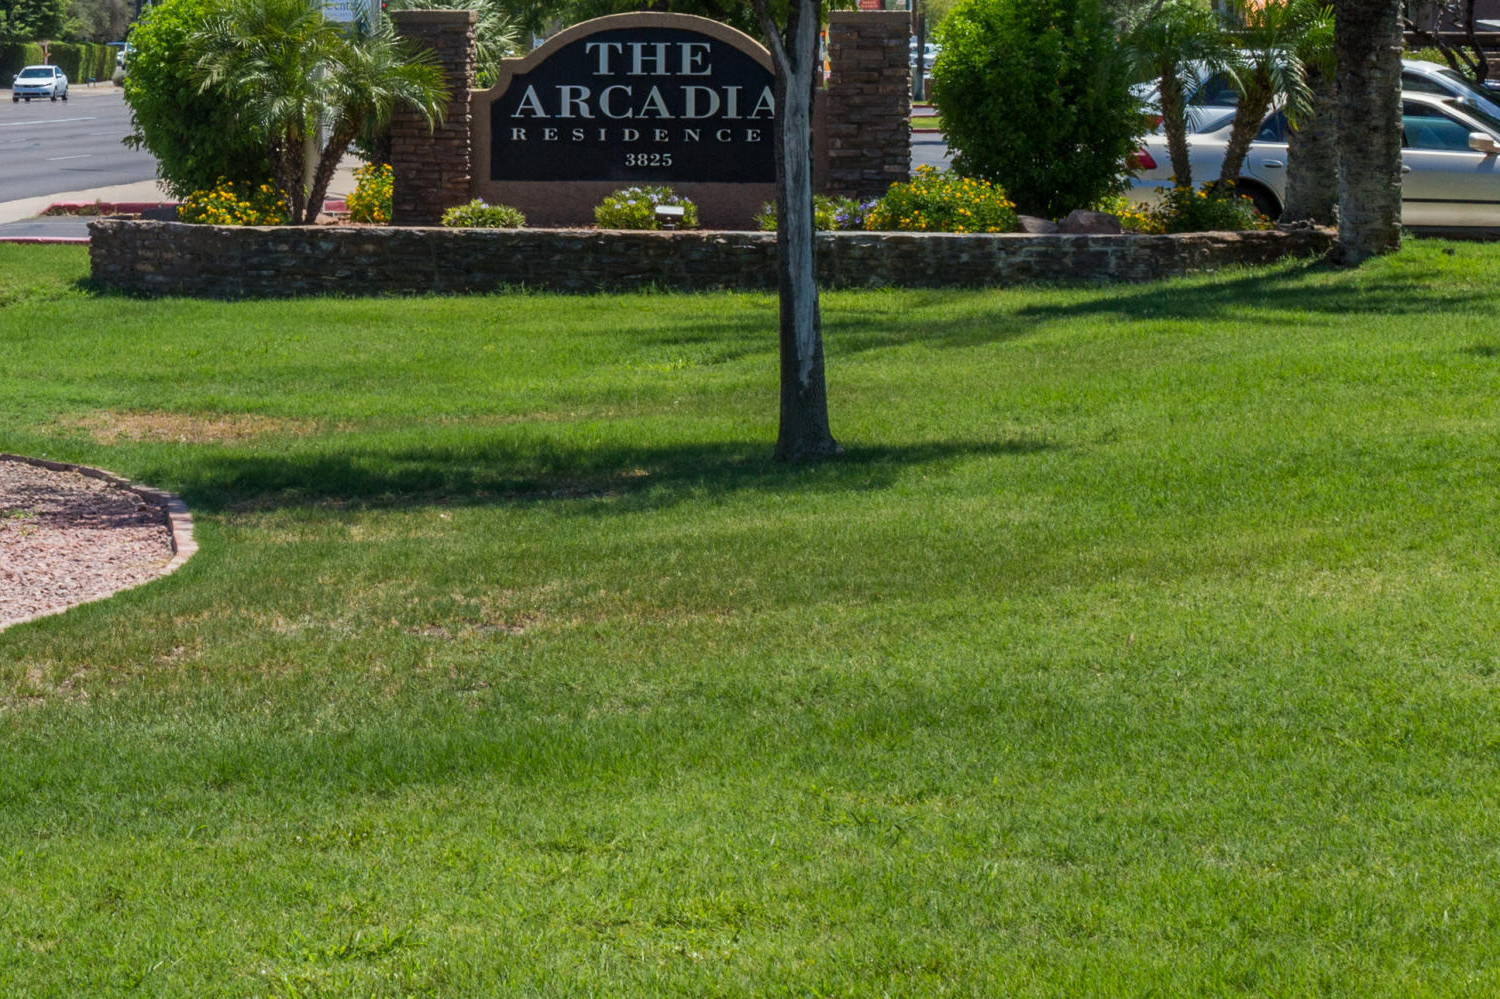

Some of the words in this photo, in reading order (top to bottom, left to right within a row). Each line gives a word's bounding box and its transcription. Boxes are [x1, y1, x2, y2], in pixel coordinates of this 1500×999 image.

[585, 42, 712, 76] THE
[510, 84, 775, 119] ARCADIA
[510, 128, 762, 142] RESIDENCE
[625, 153, 673, 167] 3825
